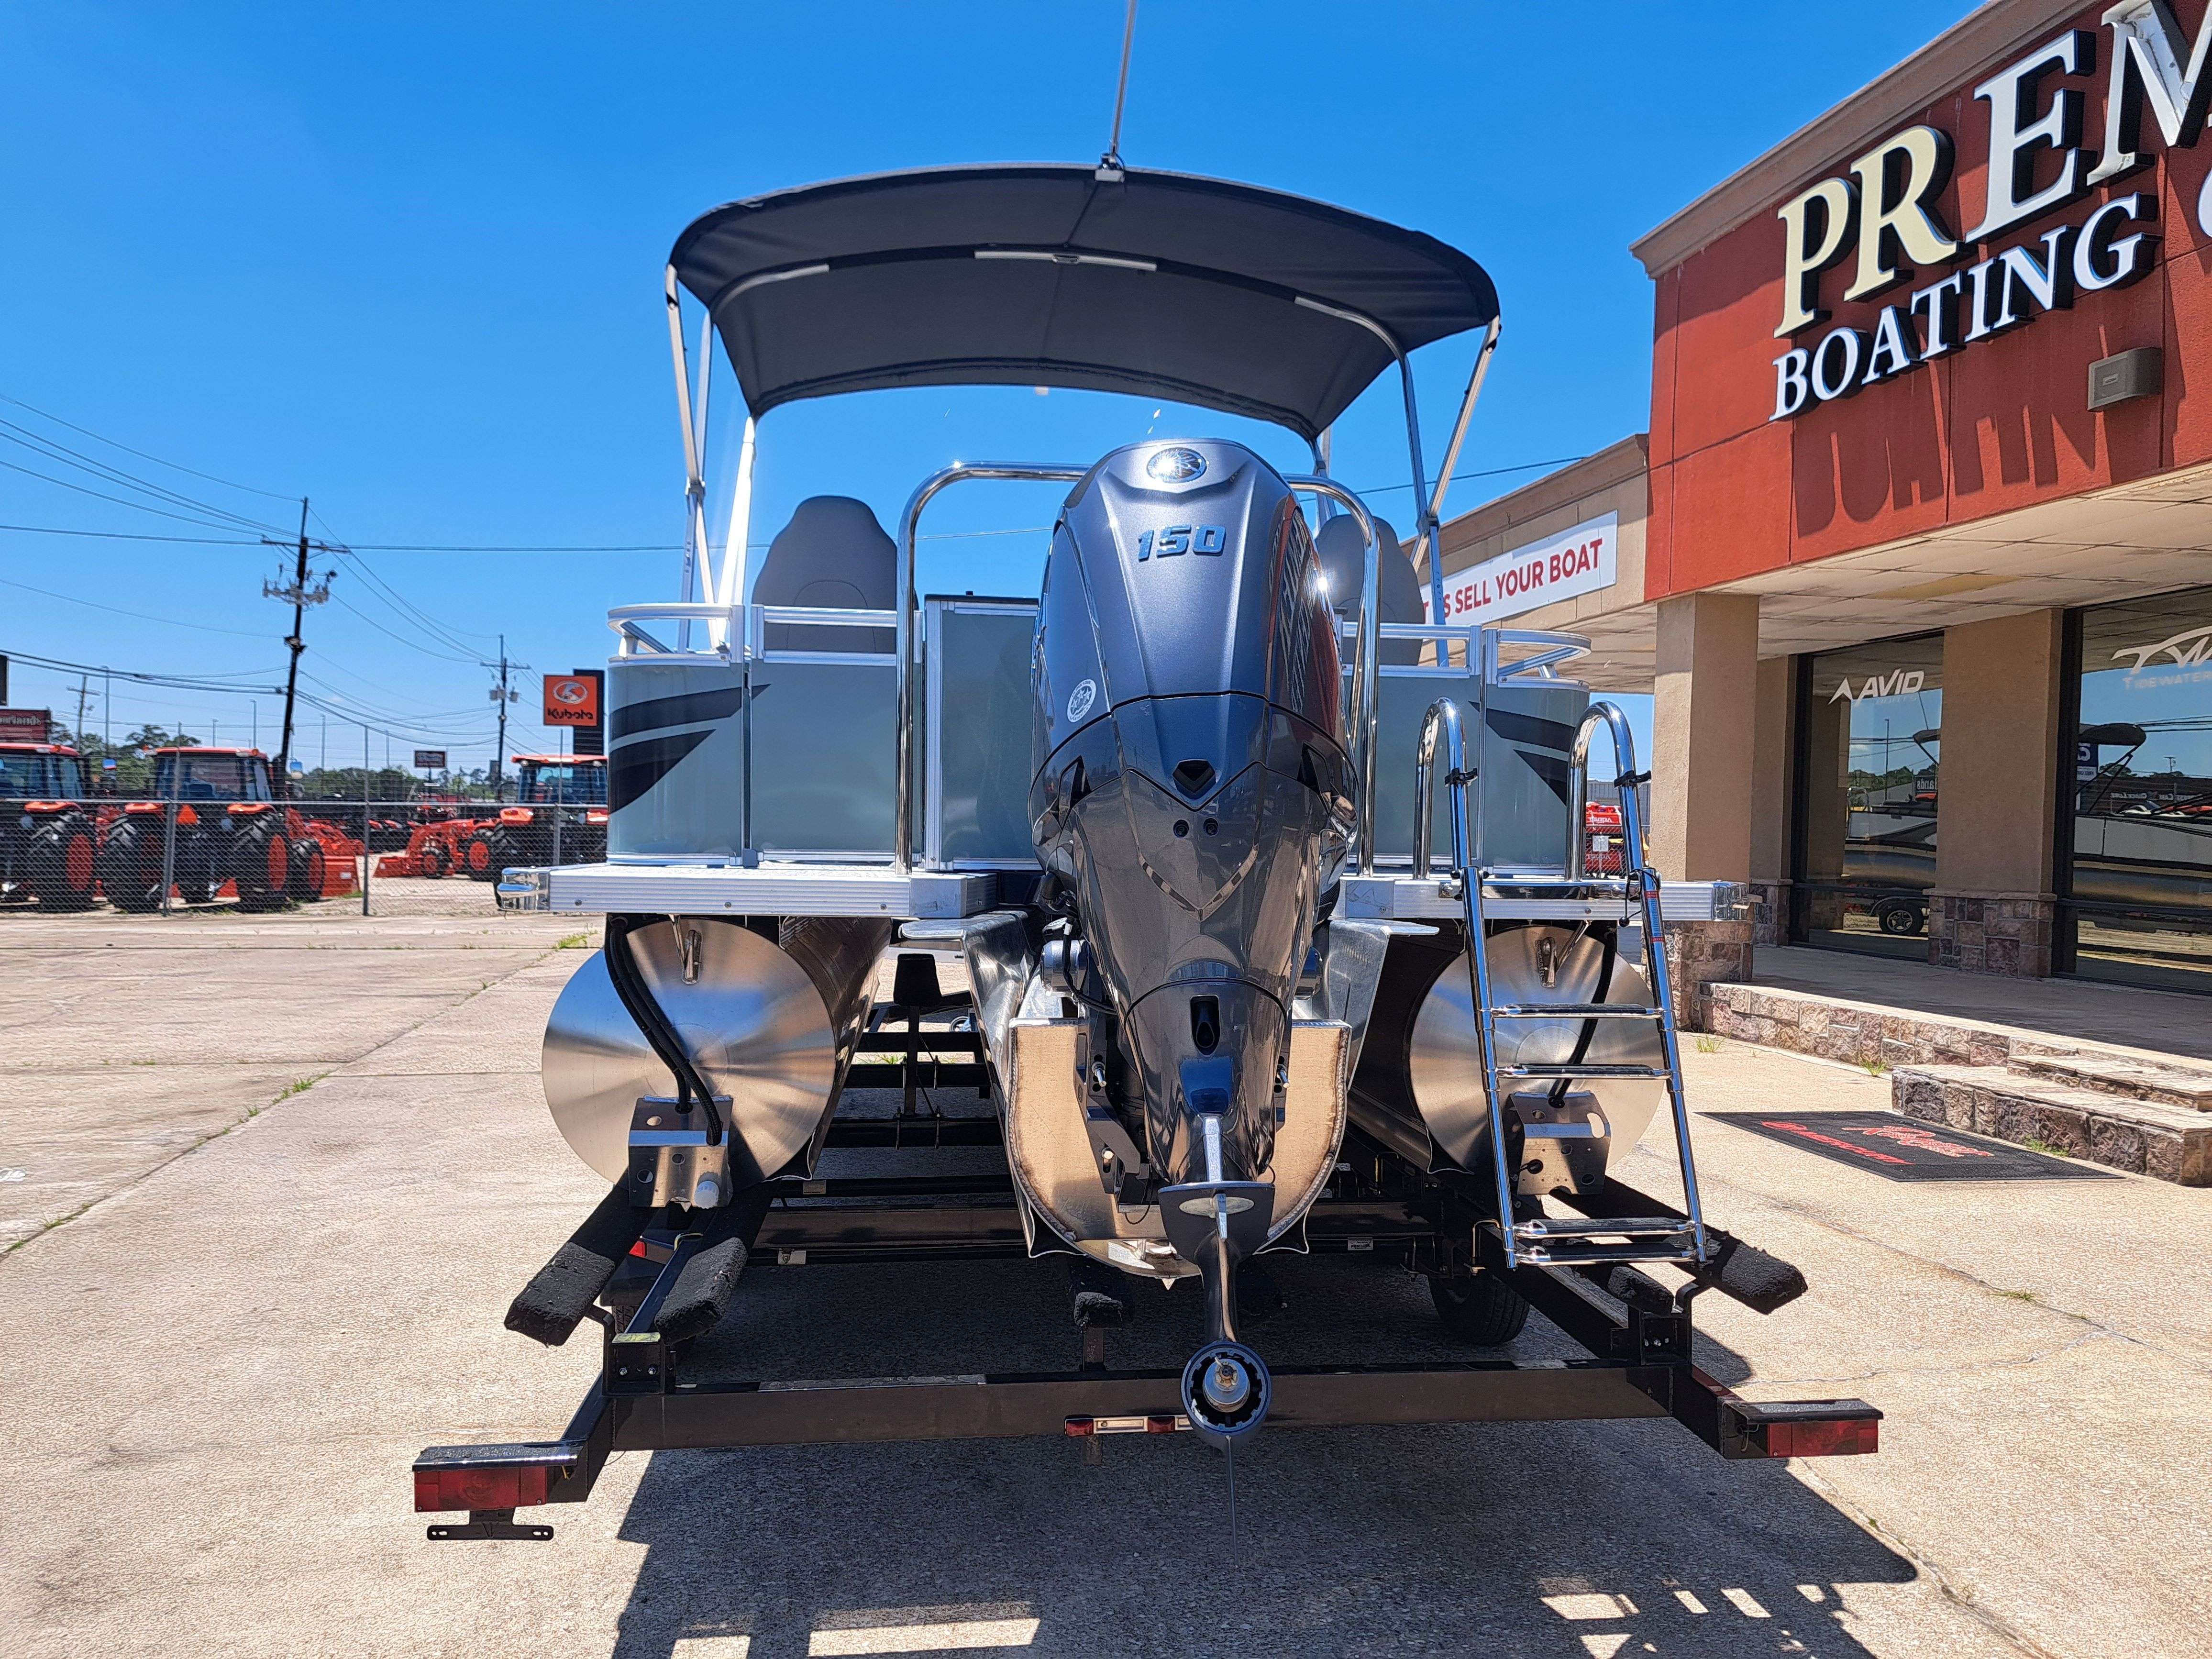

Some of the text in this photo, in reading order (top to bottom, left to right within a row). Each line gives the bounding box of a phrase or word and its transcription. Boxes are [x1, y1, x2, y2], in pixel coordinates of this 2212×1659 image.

[1768, 191, 2149, 422] BOATING
[1137, 524, 1227, 563] 150
[1455, 580, 1491, 614] SELL
[1495, 559, 1544, 600] YOUR
[1549, 538, 1603, 583] BOAT
[1853, 668, 1925, 702] AVID
[547, 707, 594, 720] Kubota
